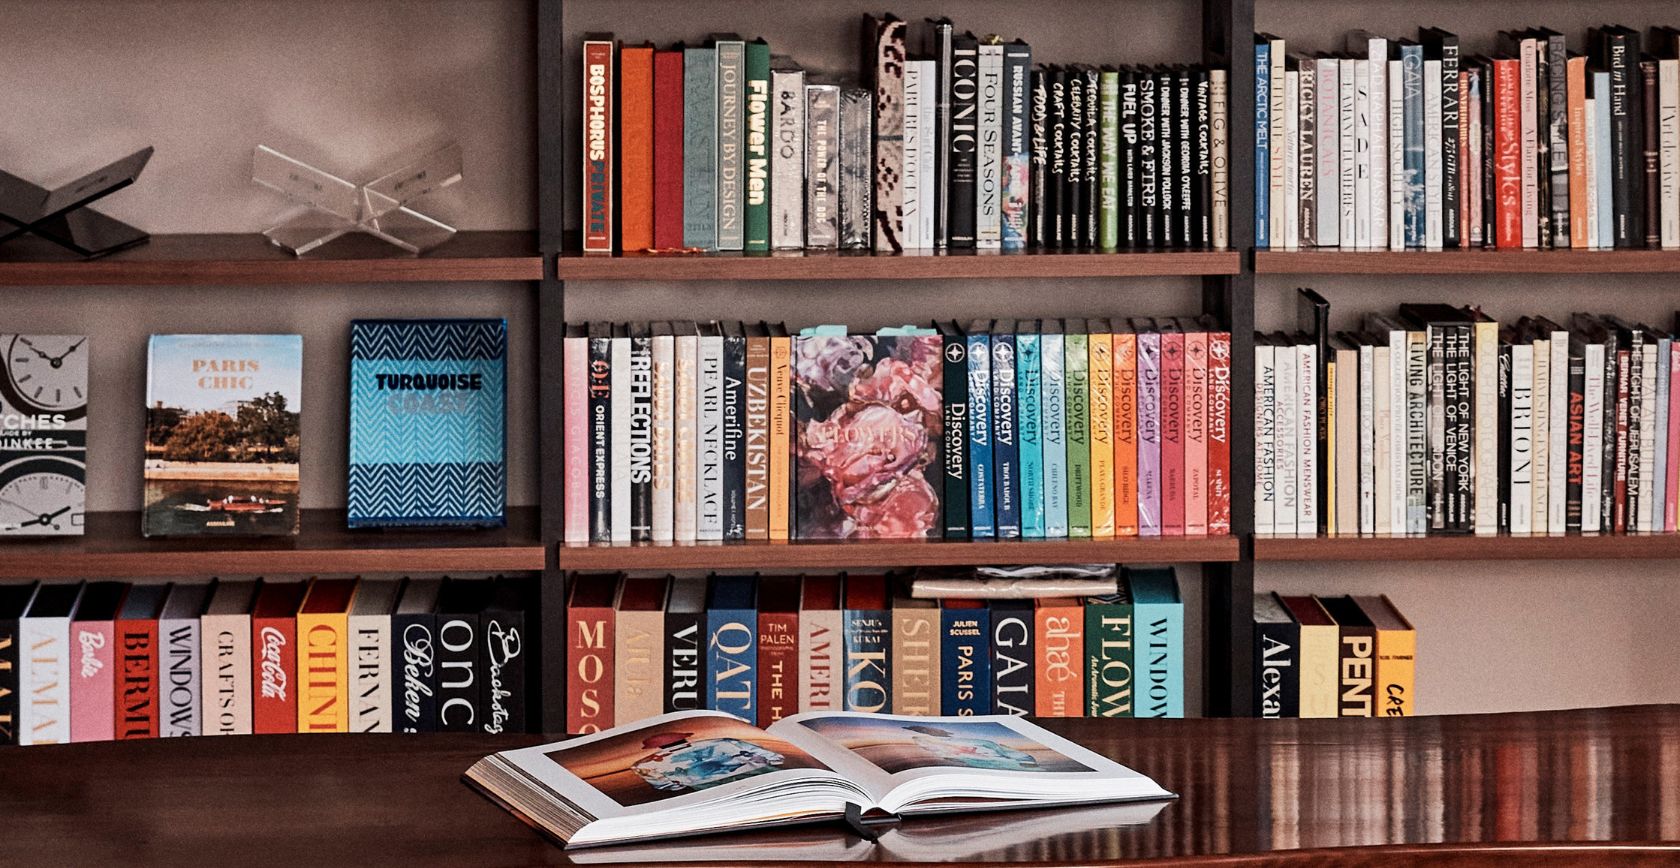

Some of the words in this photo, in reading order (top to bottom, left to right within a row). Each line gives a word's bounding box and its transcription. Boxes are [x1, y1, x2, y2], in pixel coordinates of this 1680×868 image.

[1256, 52, 1267, 76] THE
[1403, 54, 1420, 100] GAIA
[1551, 41, 1564, 105] RACING
[1613, 45, 1625, 68] Bird
[1613, 70, 1624, 82] in
[720, 63, 736, 144] JOURNEY
[953, 48, 976, 153] ICONIC
[984, 73, 998, 123] FOUR
[1012, 65, 1023, 114] RUSSIAN
[1053, 83, 1064, 118] CRAFT
[1070, 79, 1082, 130] CELEBRITY
[1085, 83, 1097, 127] TEQUILA
[1123, 84, 1136, 118] FUEL
[1161, 87, 1170, 116] DINNER
[1179, 87, 1189, 117] DINNER
[1197, 81, 1208, 122] VINTAGE
[1257, 77, 1267, 122] ARCTIC
[1299, 70, 1314, 123] RICKY
[1443, 45, 1459, 130] FERRARI
[1613, 84, 1626, 116] Hand
[590, 64, 605, 160] BOSPHORUS
[748, 80, 767, 155] Flower
[780, 91, 795, 159] BARDO
[816, 119, 827, 136] THE
[1102, 100, 1117, 123] THE
[1140, 80, 1155, 141] SMOKE
[1161, 118, 1171, 138] WITH
[1180, 119, 1189, 139] WITH
[1213, 101, 1225, 130] FIG
[1322, 68, 1334, 177] BOTANICALS
[1372, 90, 1384, 164] RAPHAEL
[1572, 107, 1584, 148] Inspired
[723, 143, 736, 161] BY
[816, 139, 827, 168] POWER
[1102, 132, 1117, 157] WAY
[1123, 123, 1136, 144] UP
[1141, 145, 1154, 156] &
[1213, 139, 1224, 148] &
[1257, 121, 1267, 149] MELT
[1525, 138, 1535, 164] Flair
[816, 172, 827, 182] OF
[983, 130, 998, 215] SEASONS
[1102, 161, 1117, 182] WE
[1161, 139, 1171, 176] JACKSON
[1181, 141, 1190, 174] GEORGIA
[1299, 130, 1314, 201] LAUREN
[1496, 143, 1521, 206] Styles
[1526, 166, 1536, 181] for
[591, 160, 606, 232] PRIVATE
[722, 166, 736, 230] DESIGN
[748, 158, 767, 206] Men
[816, 186, 827, 202] THE
[1102, 187, 1117, 210] EAT
[1141, 159, 1155, 206] FIRE
[1162, 177, 1171, 210] POLLOCK
[1181, 176, 1190, 210] O'KEEFFE
[1213, 156, 1226, 208] OLIVE
[1372, 167, 1384, 227] NASSAR
[1525, 183, 1536, 216] Living
[816, 206, 827, 224] DOG
[192, 360, 260, 372] PARIS
[1409, 342, 1424, 386] LIVING
[1432, 333, 1443, 357] THE
[1446, 333, 1456, 357] THE
[1458, 333, 1468, 357] THE
[1631, 338, 1643, 361] THE
[198, 377, 253, 389] CHIC
[375, 374, 482, 390] TURQUOISE
[704, 358, 718, 418] PEARL
[777, 364, 787, 393] Veuve
[1303, 353, 1311, 406] AMERICAN
[1432, 363, 1443, 399] LIGHT
[1446, 364, 1456, 400] LIGHT
[1458, 362, 1468, 398] LIGHT
[1498, 354, 1510, 398] Cadillac
[1588, 376, 1601, 401] The
[1619, 356, 1629, 393] BERNAR
[1631, 366, 1642, 402] LIGHT
[630, 356, 652, 484] REFLECTIONS
[724, 375, 742, 461] Amerifine
[773, 394, 787, 435] Clicquot
[971, 369, 987, 446] Discovery
[996, 369, 1014, 446] Discovery
[1023, 370, 1039, 446] Discovery
[1070, 370, 1085, 445] Discovery
[1097, 369, 1112, 444] Discovery
[1118, 369, 1135, 444] Discovery
[1142, 369, 1159, 444] Discovery
[1165, 368, 1182, 444] Discovery
[1188, 367, 1205, 443] Discovery
[1211, 366, 1229, 442] Discovery
[1262, 366, 1273, 436] AMERICAN
[1283, 362, 1295, 437] AMERICAN
[1446, 405, 1456, 422] OF
[1458, 402, 1468, 419] OF
[1568, 392, 1582, 445] ASIAN
[1618, 398, 1628, 426] VENET
[1630, 406, 1641, 422] OF
[595, 404, 605, 445] ORIENT
[747, 366, 767, 511] UZBEKISTAN
[948, 402, 965, 480] Discovery
[1303, 410, 1311, 455] FASHION
[1409, 392, 1424, 495] ARCHITECTURE
[1458, 423, 1468, 452] NEW
[1513, 387, 1532, 485] BRIONI
[1256, 441, 1263, 453] AT
[1446, 427, 1456, 471] VENICE
[1568, 450, 1582, 485] ART
[1617, 431, 1627, 482] FURNITURE
[1627, 426, 1641, 496] JERUSALEM
[595, 447, 605, 499] EXPRESS
[704, 424, 718, 524] NECKLACE
[1002, 462, 1010, 511] TROUBADOUR
[1074, 464, 1083, 507] DRIFTWOOD
[1263, 442, 1274, 502] FASHION
[1284, 443, 1295, 507] FASHION
[1303, 459, 1311, 516] MENSWEAR
[1458, 456, 1468, 491] YORK
[1587, 473, 1599, 499] Life
[760, 635, 795, 644] PALEN
[769, 624, 787, 632] TIM
[1045, 616, 1081, 682] ahaé
[79, 630, 105, 678] Barbie
[218, 631, 235, 708] CRAFTS
[403, 623, 434, 722] Beken
[958, 645, 973, 700] PARIS
[771, 660, 783, 699] THE
[1341, 636, 1373, 718] PENT
[1386, 683, 1405, 717] CRE
